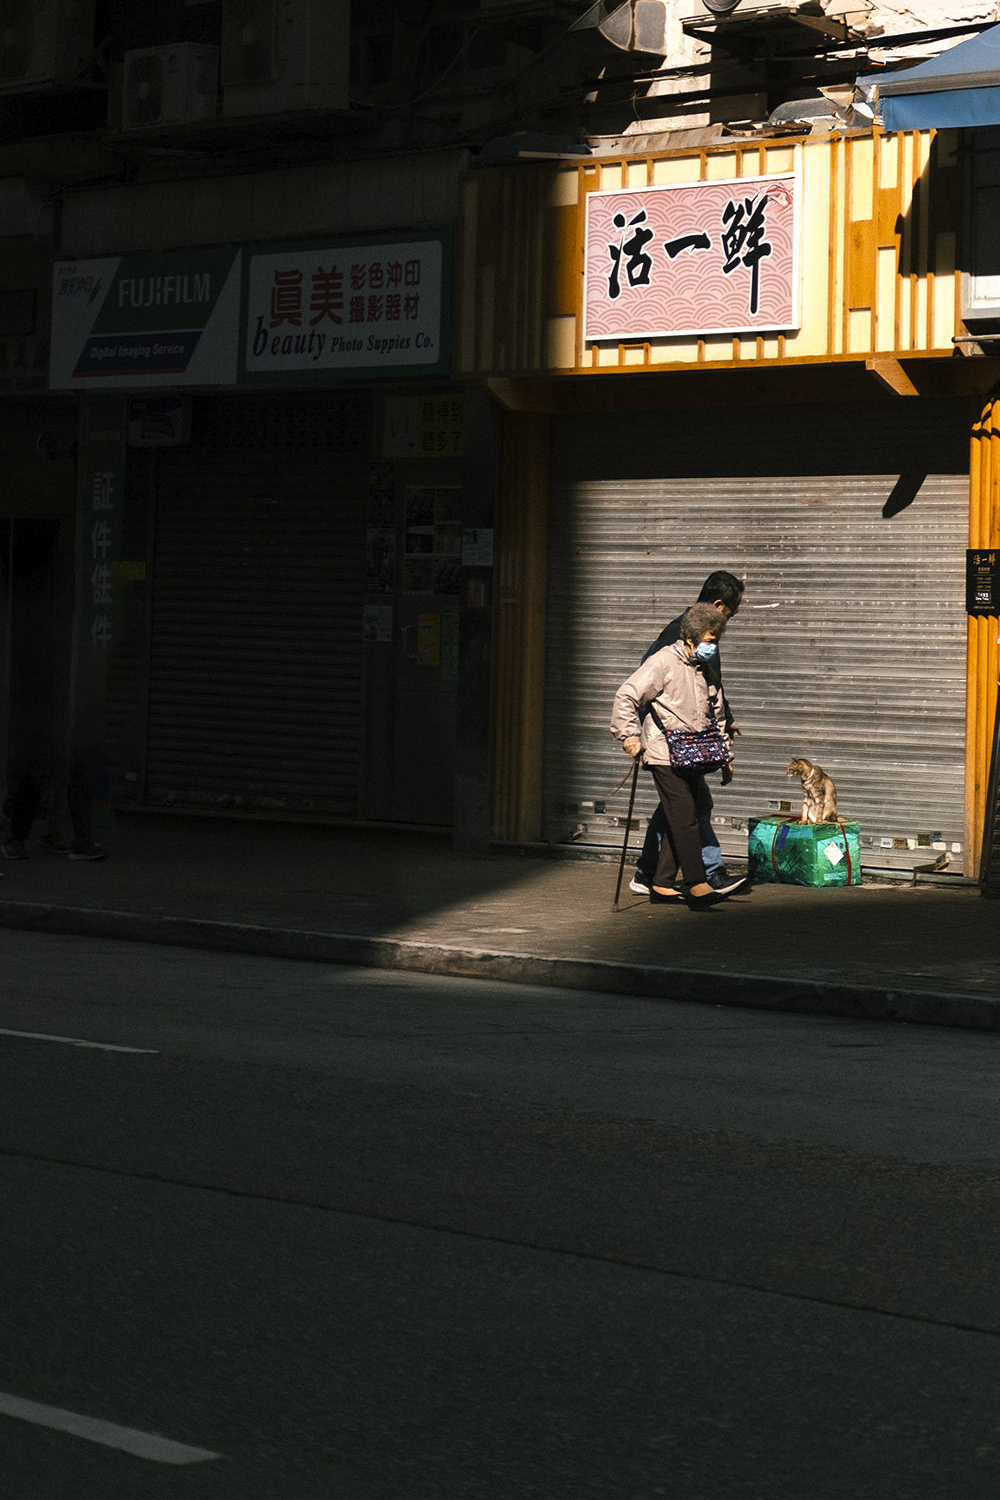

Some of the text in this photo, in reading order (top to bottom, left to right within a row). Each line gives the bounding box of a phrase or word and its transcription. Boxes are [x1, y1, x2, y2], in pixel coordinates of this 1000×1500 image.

[608, 194, 772, 315] 活一鮮
[118, 272, 211, 308] FUJIFILM
[349, 292, 421, 323] 攝影器材
[90, 343, 185, 361] Digital Imaging Service
[253, 315, 326, 361] beauty
[330, 336, 363, 353] Photo
[415, 332, 434, 348] Co.
